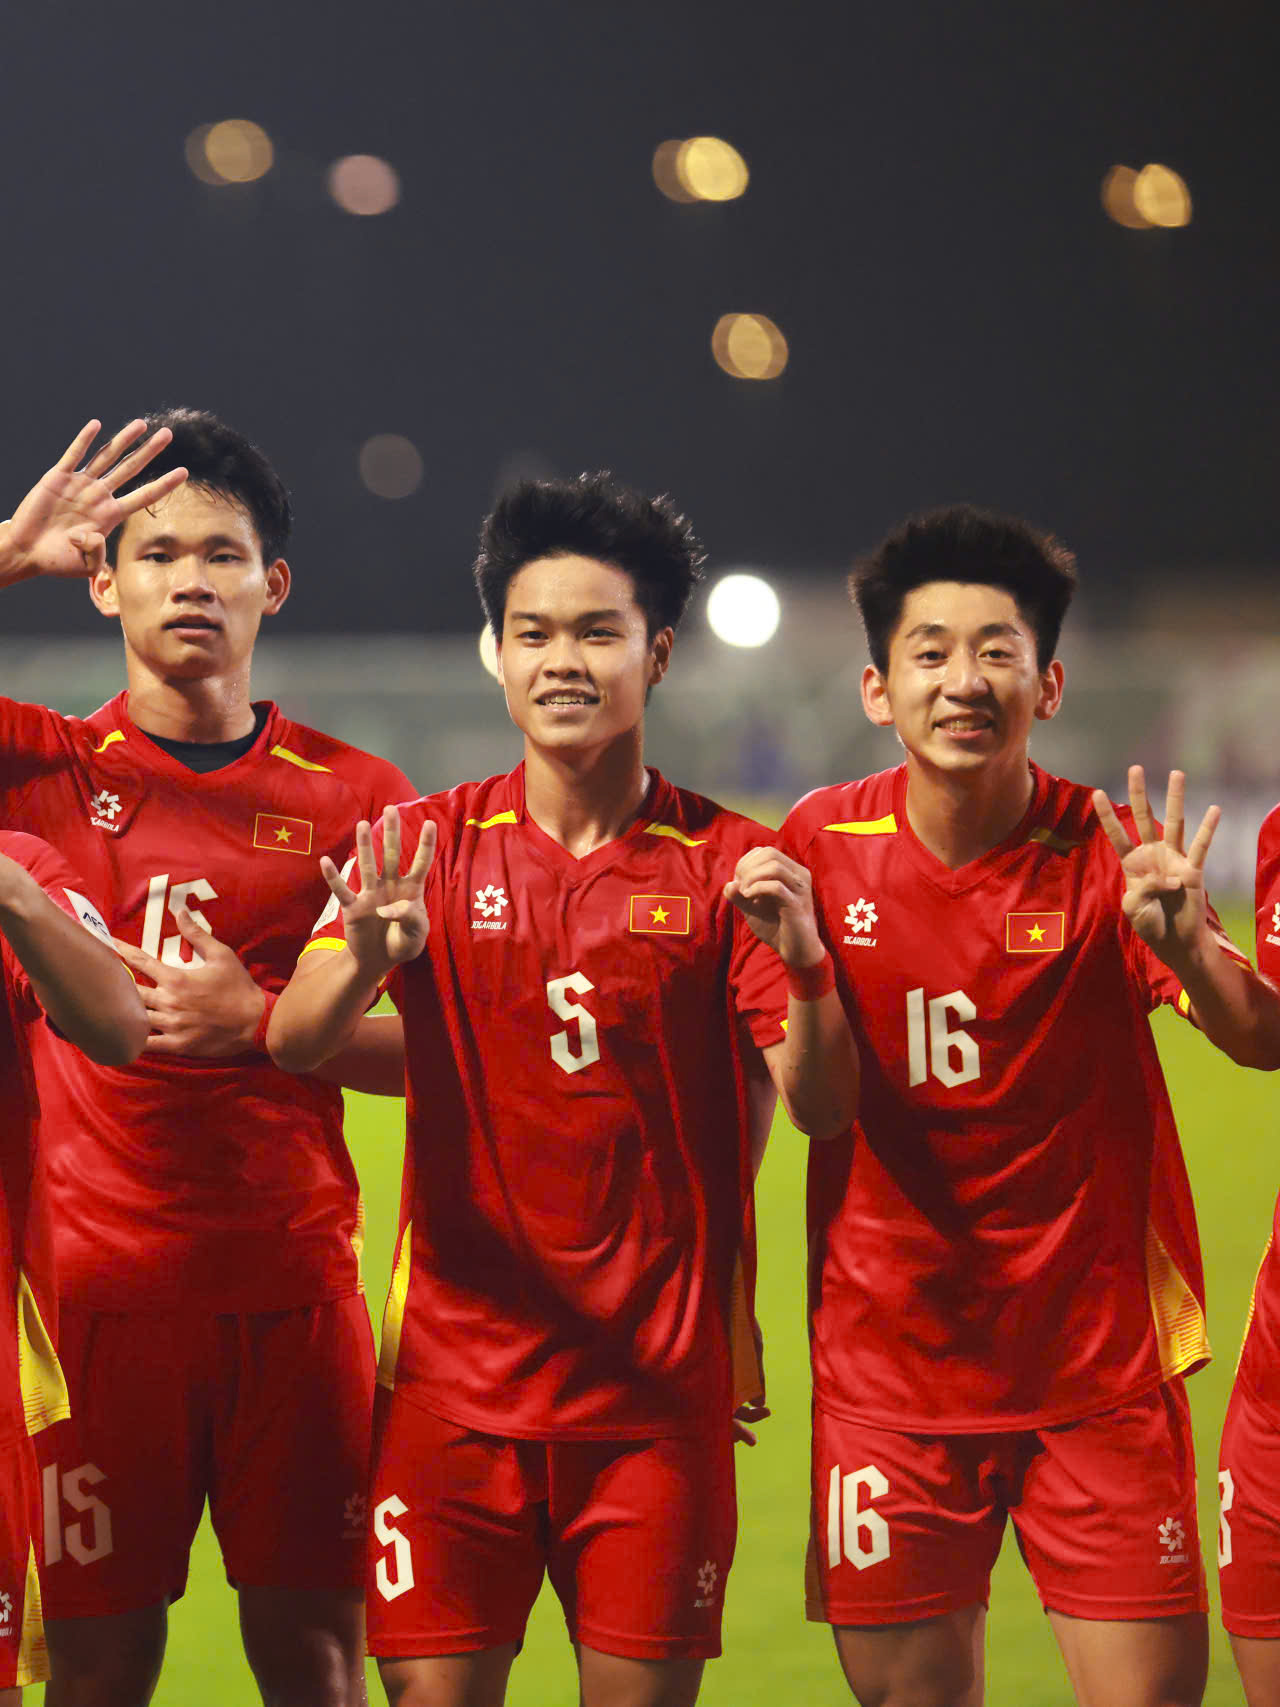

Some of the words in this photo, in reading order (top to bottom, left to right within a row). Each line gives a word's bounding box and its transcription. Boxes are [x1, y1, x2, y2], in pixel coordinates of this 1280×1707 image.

[140, 873, 219, 970] 15
[546, 970, 601, 1075] 5
[906, 987, 981, 1089] 16
[42, 1462, 113, 1567] 15
[373, 1494, 415, 1603] 5
[827, 1463, 891, 1571] 16
